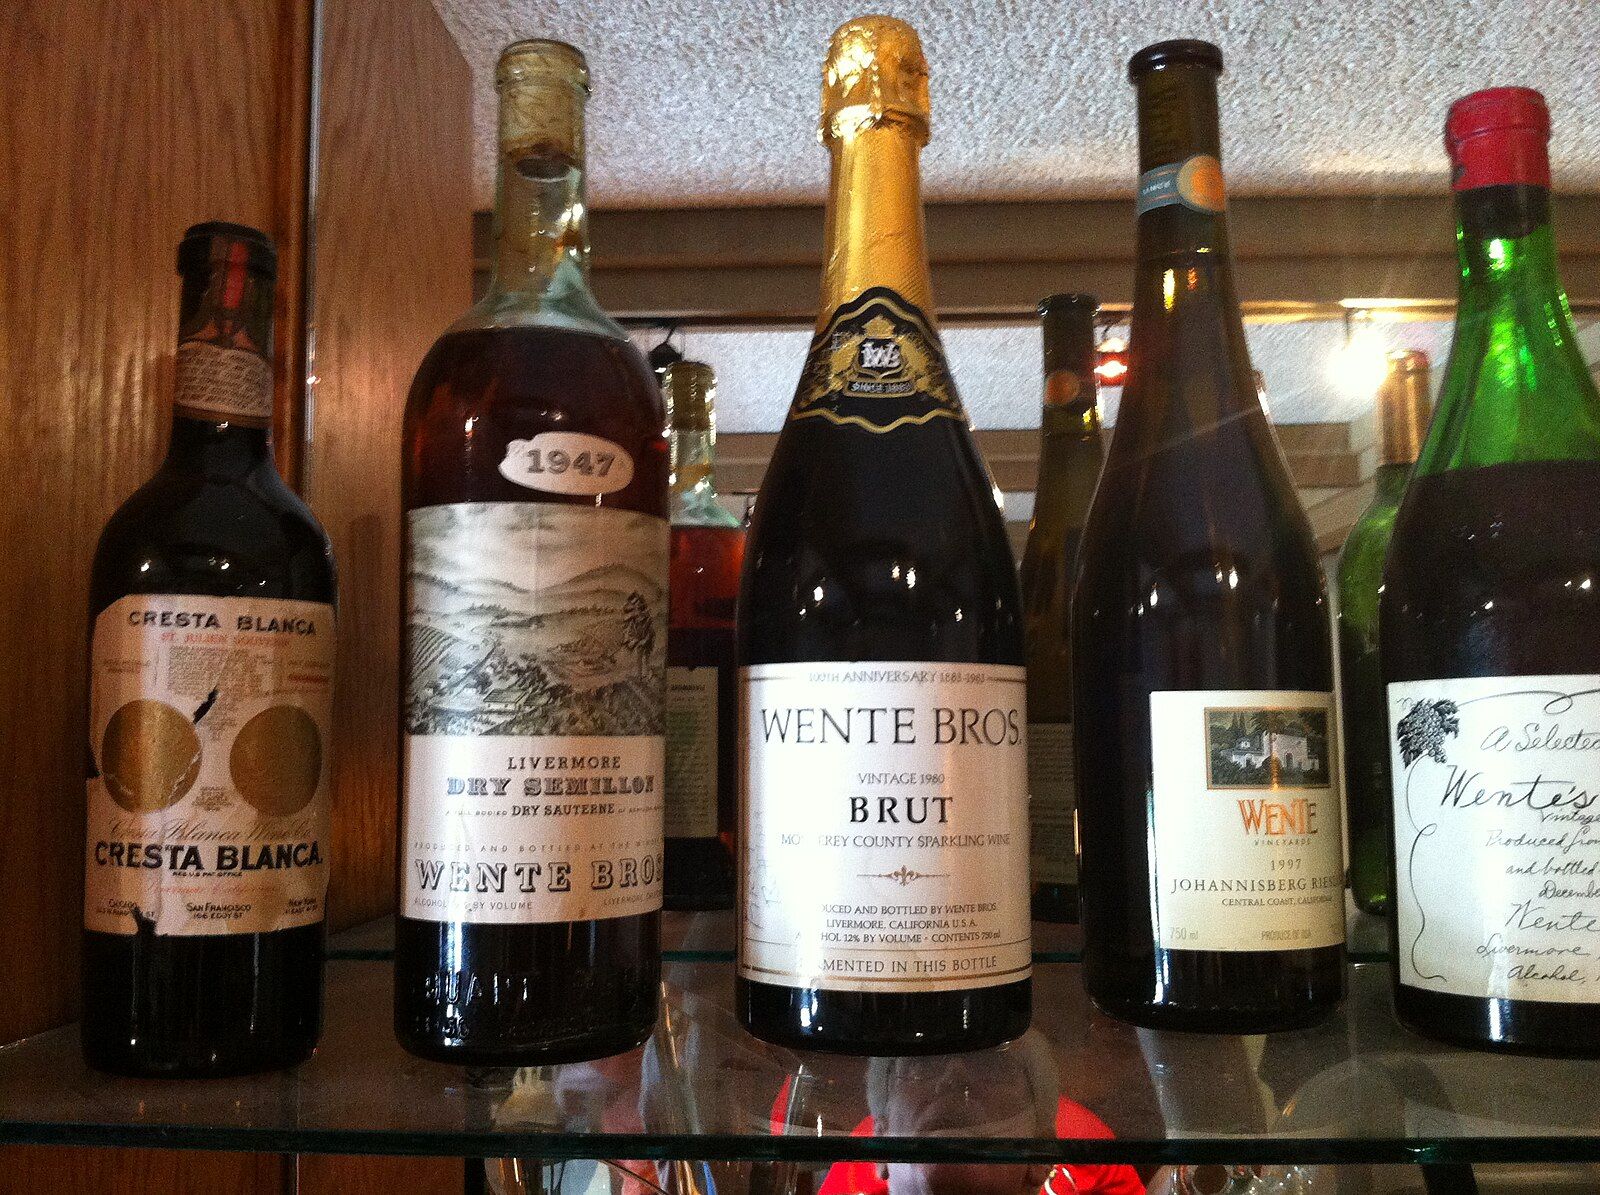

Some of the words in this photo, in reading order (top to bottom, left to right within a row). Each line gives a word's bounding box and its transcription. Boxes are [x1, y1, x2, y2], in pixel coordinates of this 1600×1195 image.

[527, 449, 616, 477] 1947
[128, 611, 221, 630] CRESTA
[237, 615, 317, 636] BLANCA
[842, 670, 938, 683] ANNIVERSARY
[761, 707, 917, 744] WENTE
[933, 706, 1022, 746] BROS.
[508, 756, 621, 770] LIVERMORE
[447, 776, 511, 796] DRY
[524, 775, 655, 797] SEMILLON
[858, 772, 917, 785] VINTAGE
[920, 772, 945, 785] 1980
[1440, 764, 1599, 810] Wente's
[512, 804, 540, 817] DRY
[544, 803, 615, 817] SAUTERNE
[850, 796, 953, 824] BRUT
[1237, 798, 1319, 836] WENTE
[853, 835, 914, 848] COUNTY
[917, 833, 984, 848] SPARKLING
[987, 832, 1011, 846] WINE
[1254, 838, 1312, 846] VINEYARDS
[1485, 829, 1569, 847] Produced
[94, 841, 204, 871] CRESTA
[519, 844, 581, 852] BOTTLED
[1270, 858, 1302, 871] 1997
[1505, 861, 1539, 875] and
[1540, 856, 1600, 876] bottled
[415, 858, 572, 893] WENTE
[1171, 877, 1307, 895] JOHANNISBERG
[1538, 879, 1600, 899] Decembe
[186, 902, 204, 912] SAN
[472, 901, 485, 910] BY
[490, 901, 533, 910] VOLUME
[854, 905, 878, 915] AND
[881, 905, 927, 915] BOTTLED
[930, 905, 942, 914] BY
[944, 904, 976, 914] WENTE
[1222, 898, 1265, 906] CENTRAL
[1505, 899, 1600, 933] Wente
[826, 919, 886, 930] LIVERMORE,
[889, 919, 949, 930] CALIFORNIA
[843, 933, 860, 943] 12%
[863, 933, 876, 943] BY
[878, 934, 922, 944] VOLUME
[931, 931, 979, 943] CONTENTS
[1170, 926, 1187, 940] 750
[820, 958, 885, 973] MENTED
[892, 960, 907, 973] IN
[913, 960, 947, 973] THIS
[953, 956, 997, 971] BOTTLE
